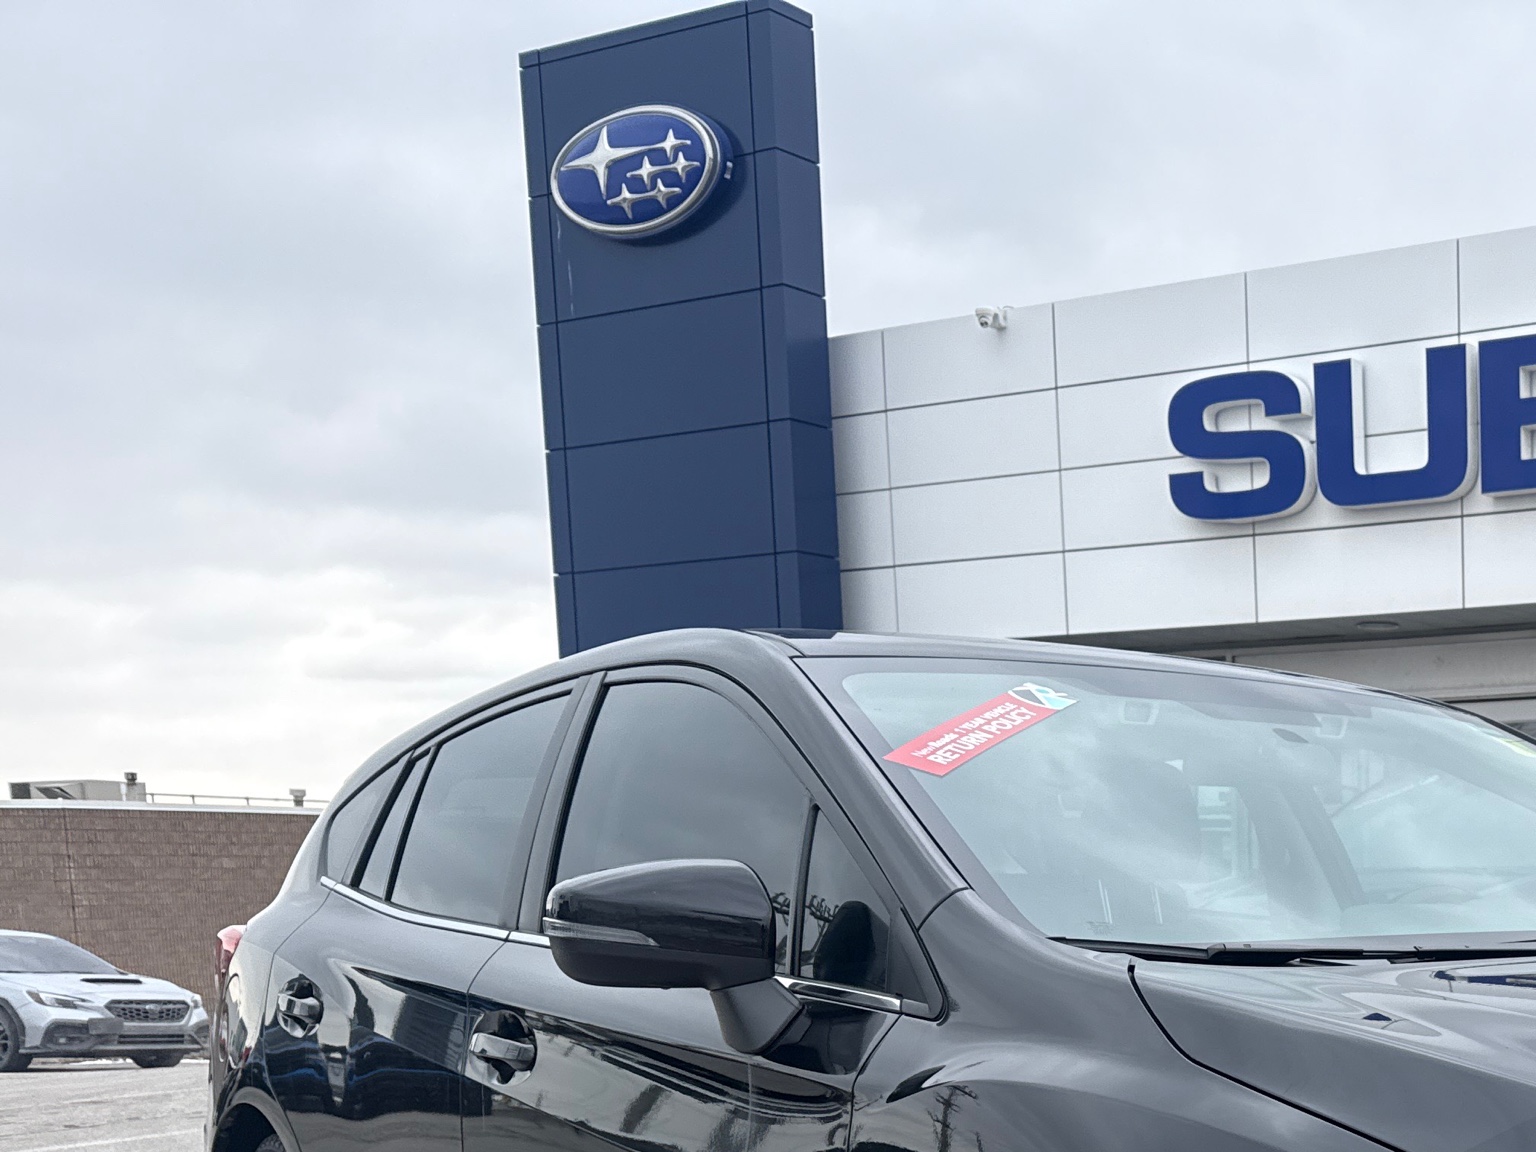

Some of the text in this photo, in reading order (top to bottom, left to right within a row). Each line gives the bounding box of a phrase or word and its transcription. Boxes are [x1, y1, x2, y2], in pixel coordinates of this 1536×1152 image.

[926, 706, 1037, 765] RETURN POLICY
[959, 716, 986, 732] YEAR
[982, 702, 1019, 723] VEHICLE
